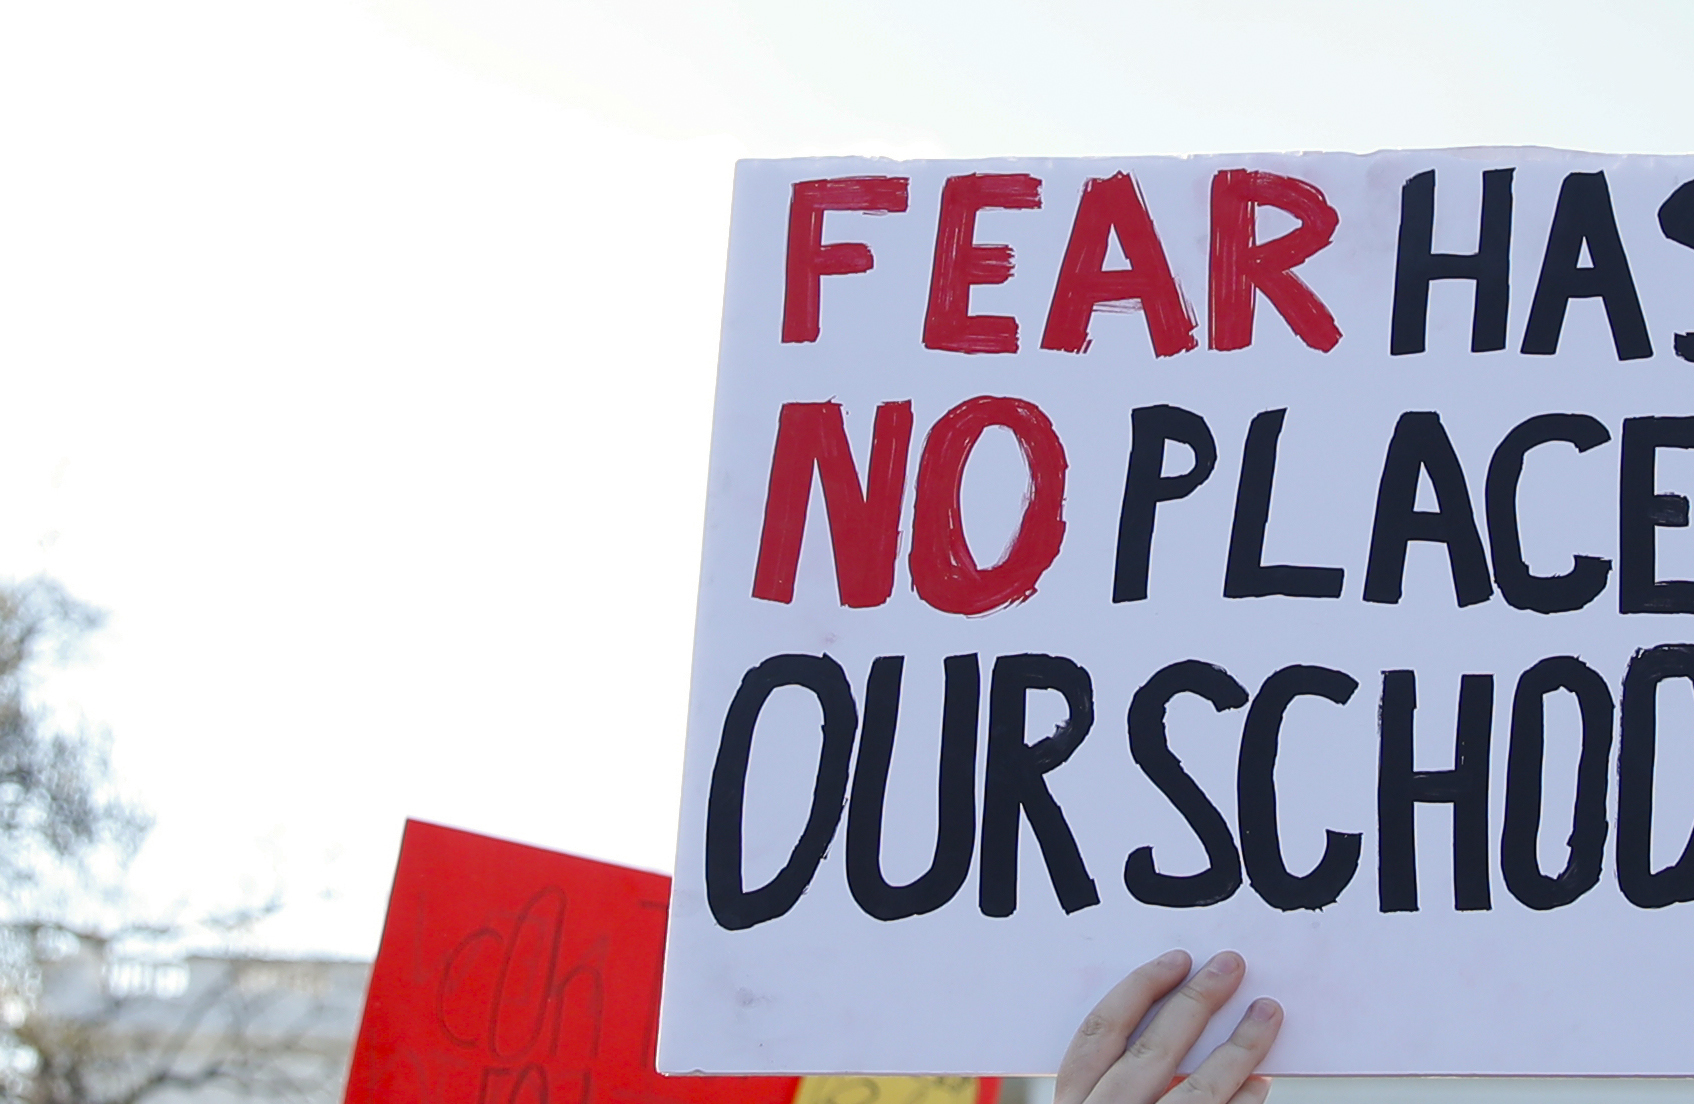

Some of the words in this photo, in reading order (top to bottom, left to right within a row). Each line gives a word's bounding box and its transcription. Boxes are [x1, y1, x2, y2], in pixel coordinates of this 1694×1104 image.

[780, 168, 1345, 358] FEAR
[751, 395, 1070, 617] NO
[705, 651, 1102, 932] OUR
